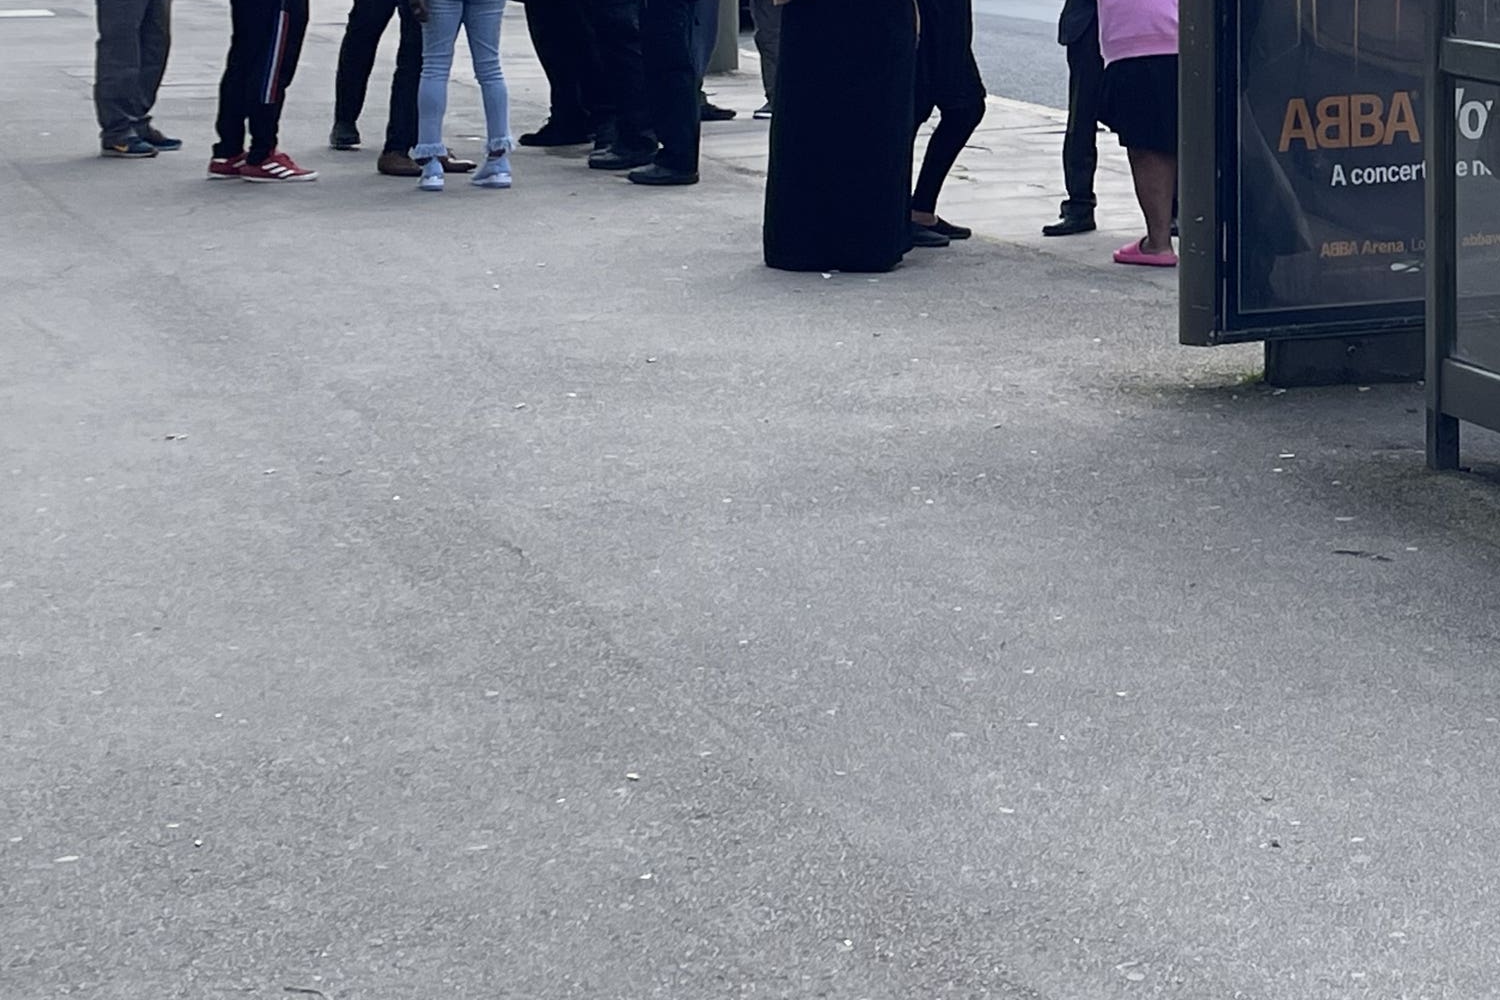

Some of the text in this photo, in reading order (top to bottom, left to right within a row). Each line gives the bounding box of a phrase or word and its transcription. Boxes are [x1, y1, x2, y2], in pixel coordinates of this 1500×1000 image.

[1278, 91, 1421, 153] ABBA
[1331, 164, 1347, 187] A
[1320, 240, 1359, 258] ABBA
